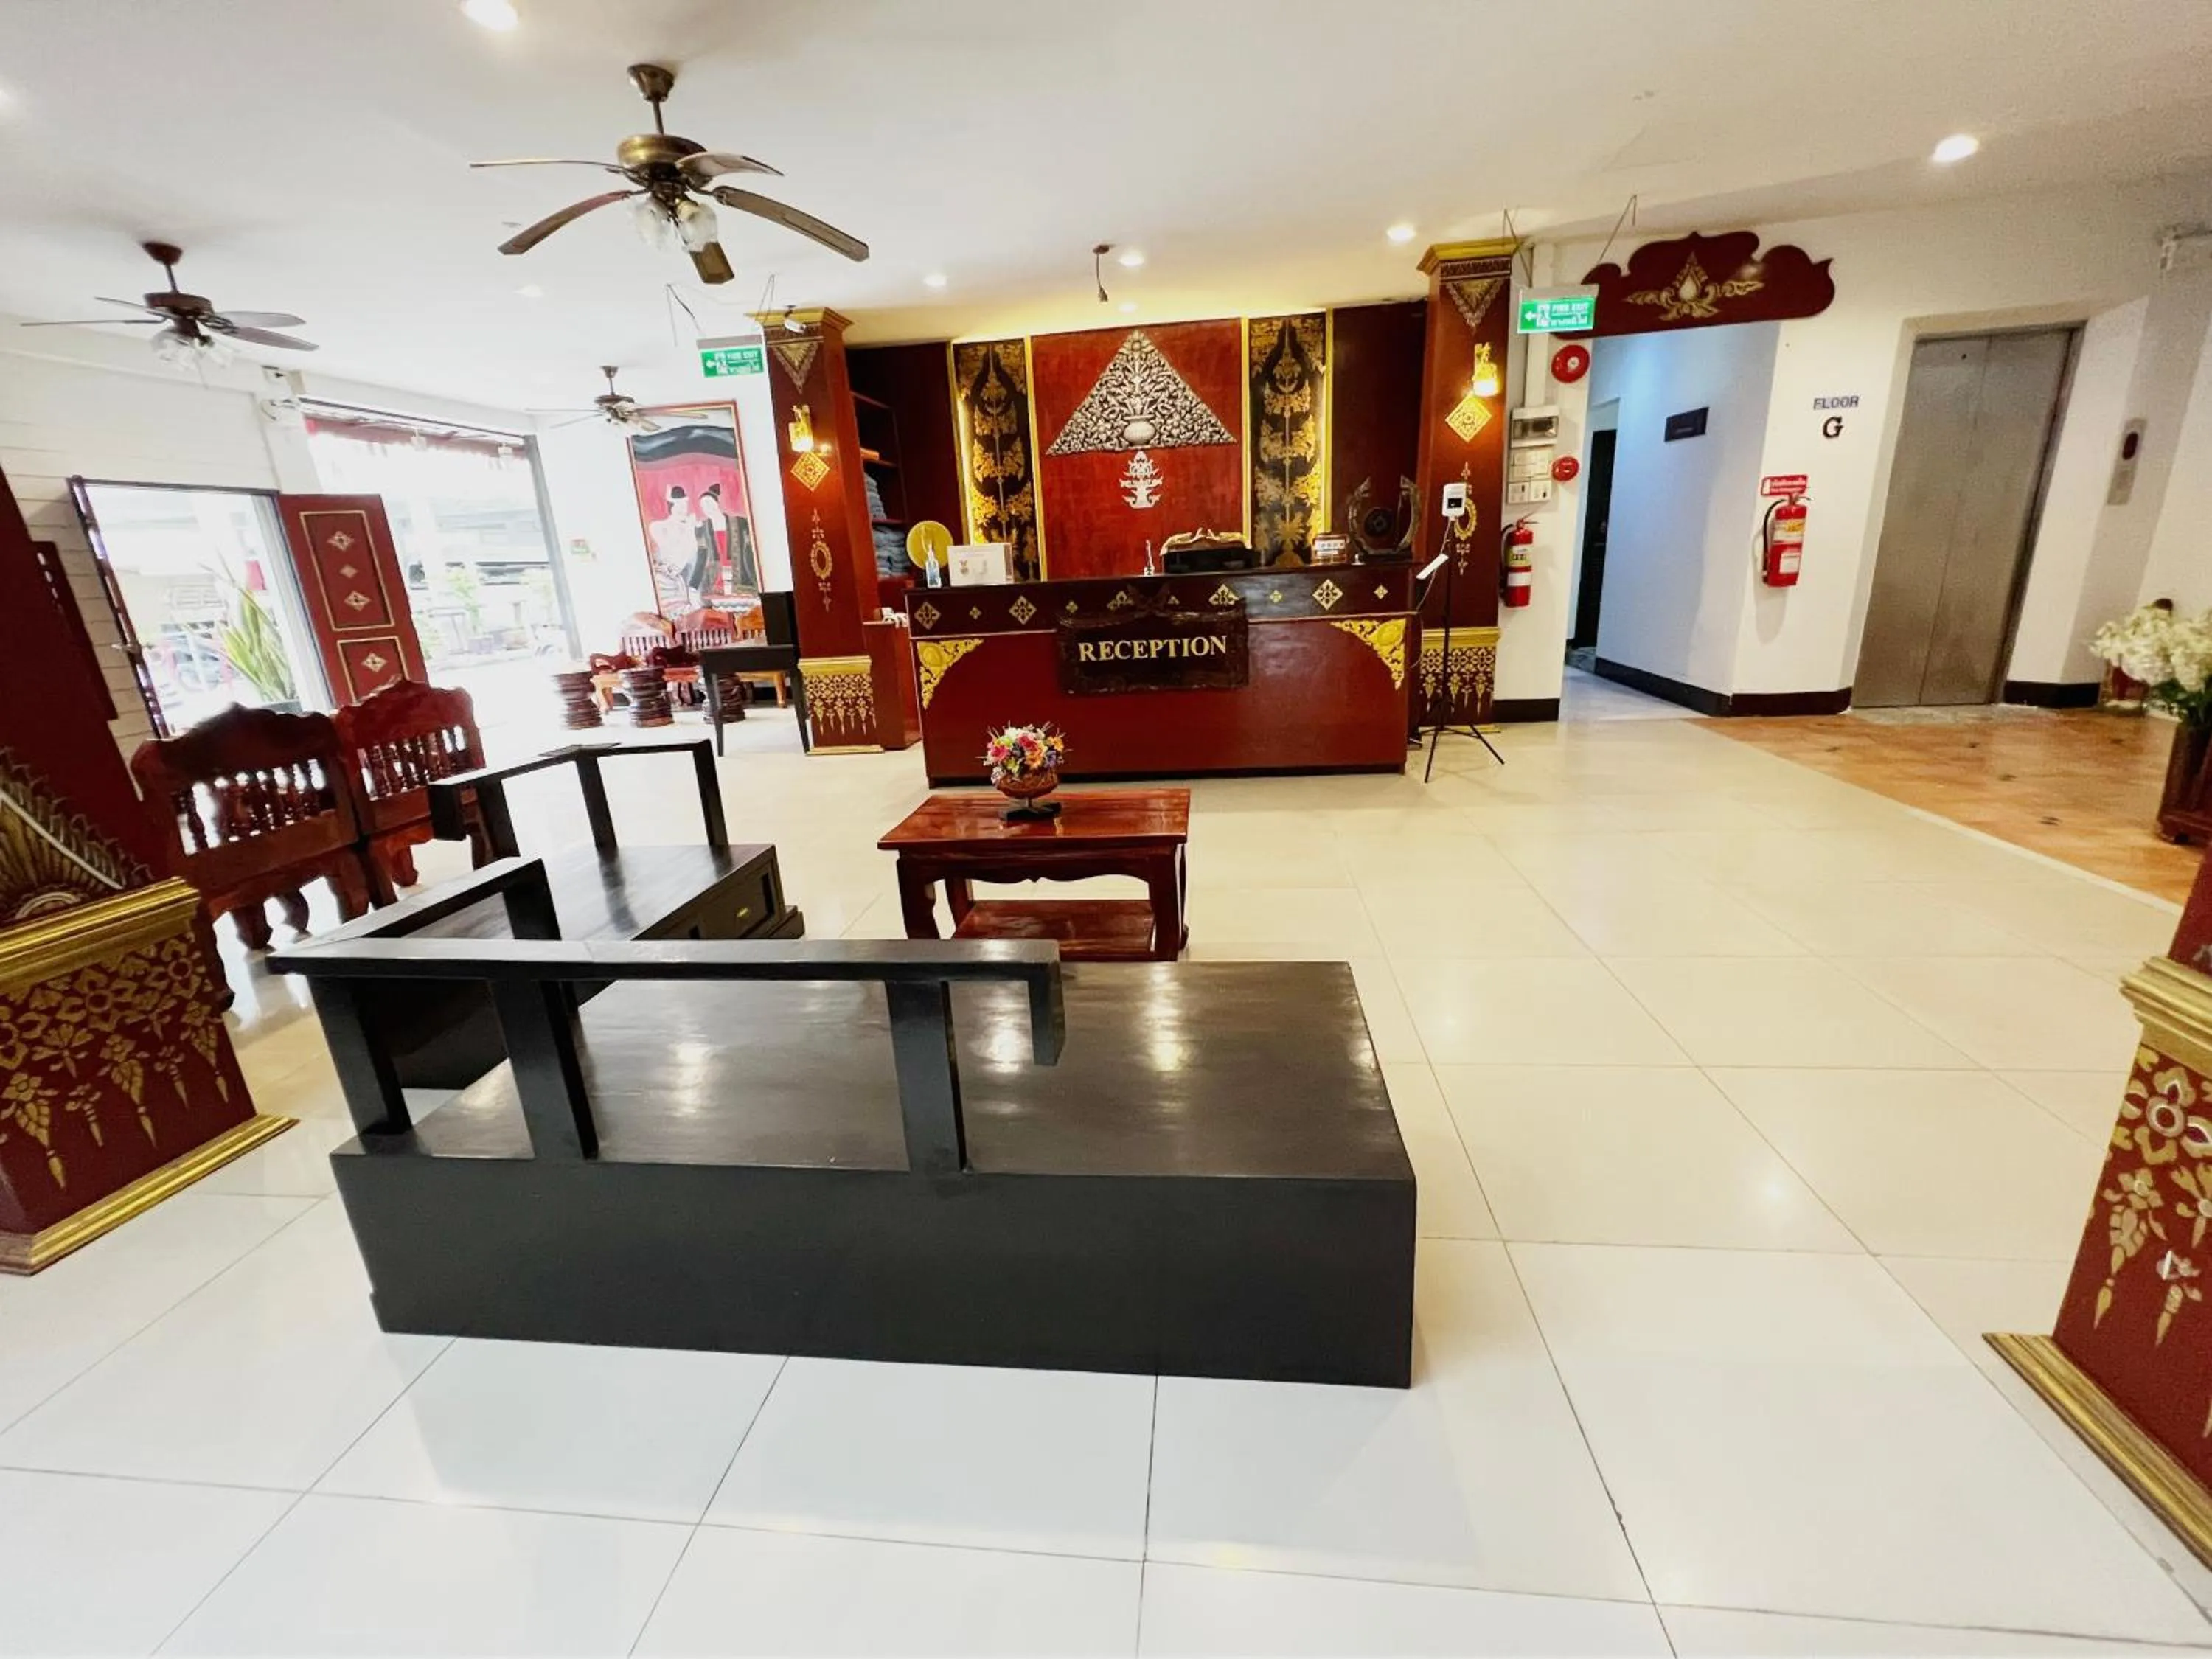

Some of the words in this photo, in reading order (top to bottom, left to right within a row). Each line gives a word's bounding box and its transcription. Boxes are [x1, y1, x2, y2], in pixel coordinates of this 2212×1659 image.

[1813, 395, 1860, 410] FLOOR
[1823, 416, 1843, 439] G
[1077, 635, 1228, 661] RECEPTION
